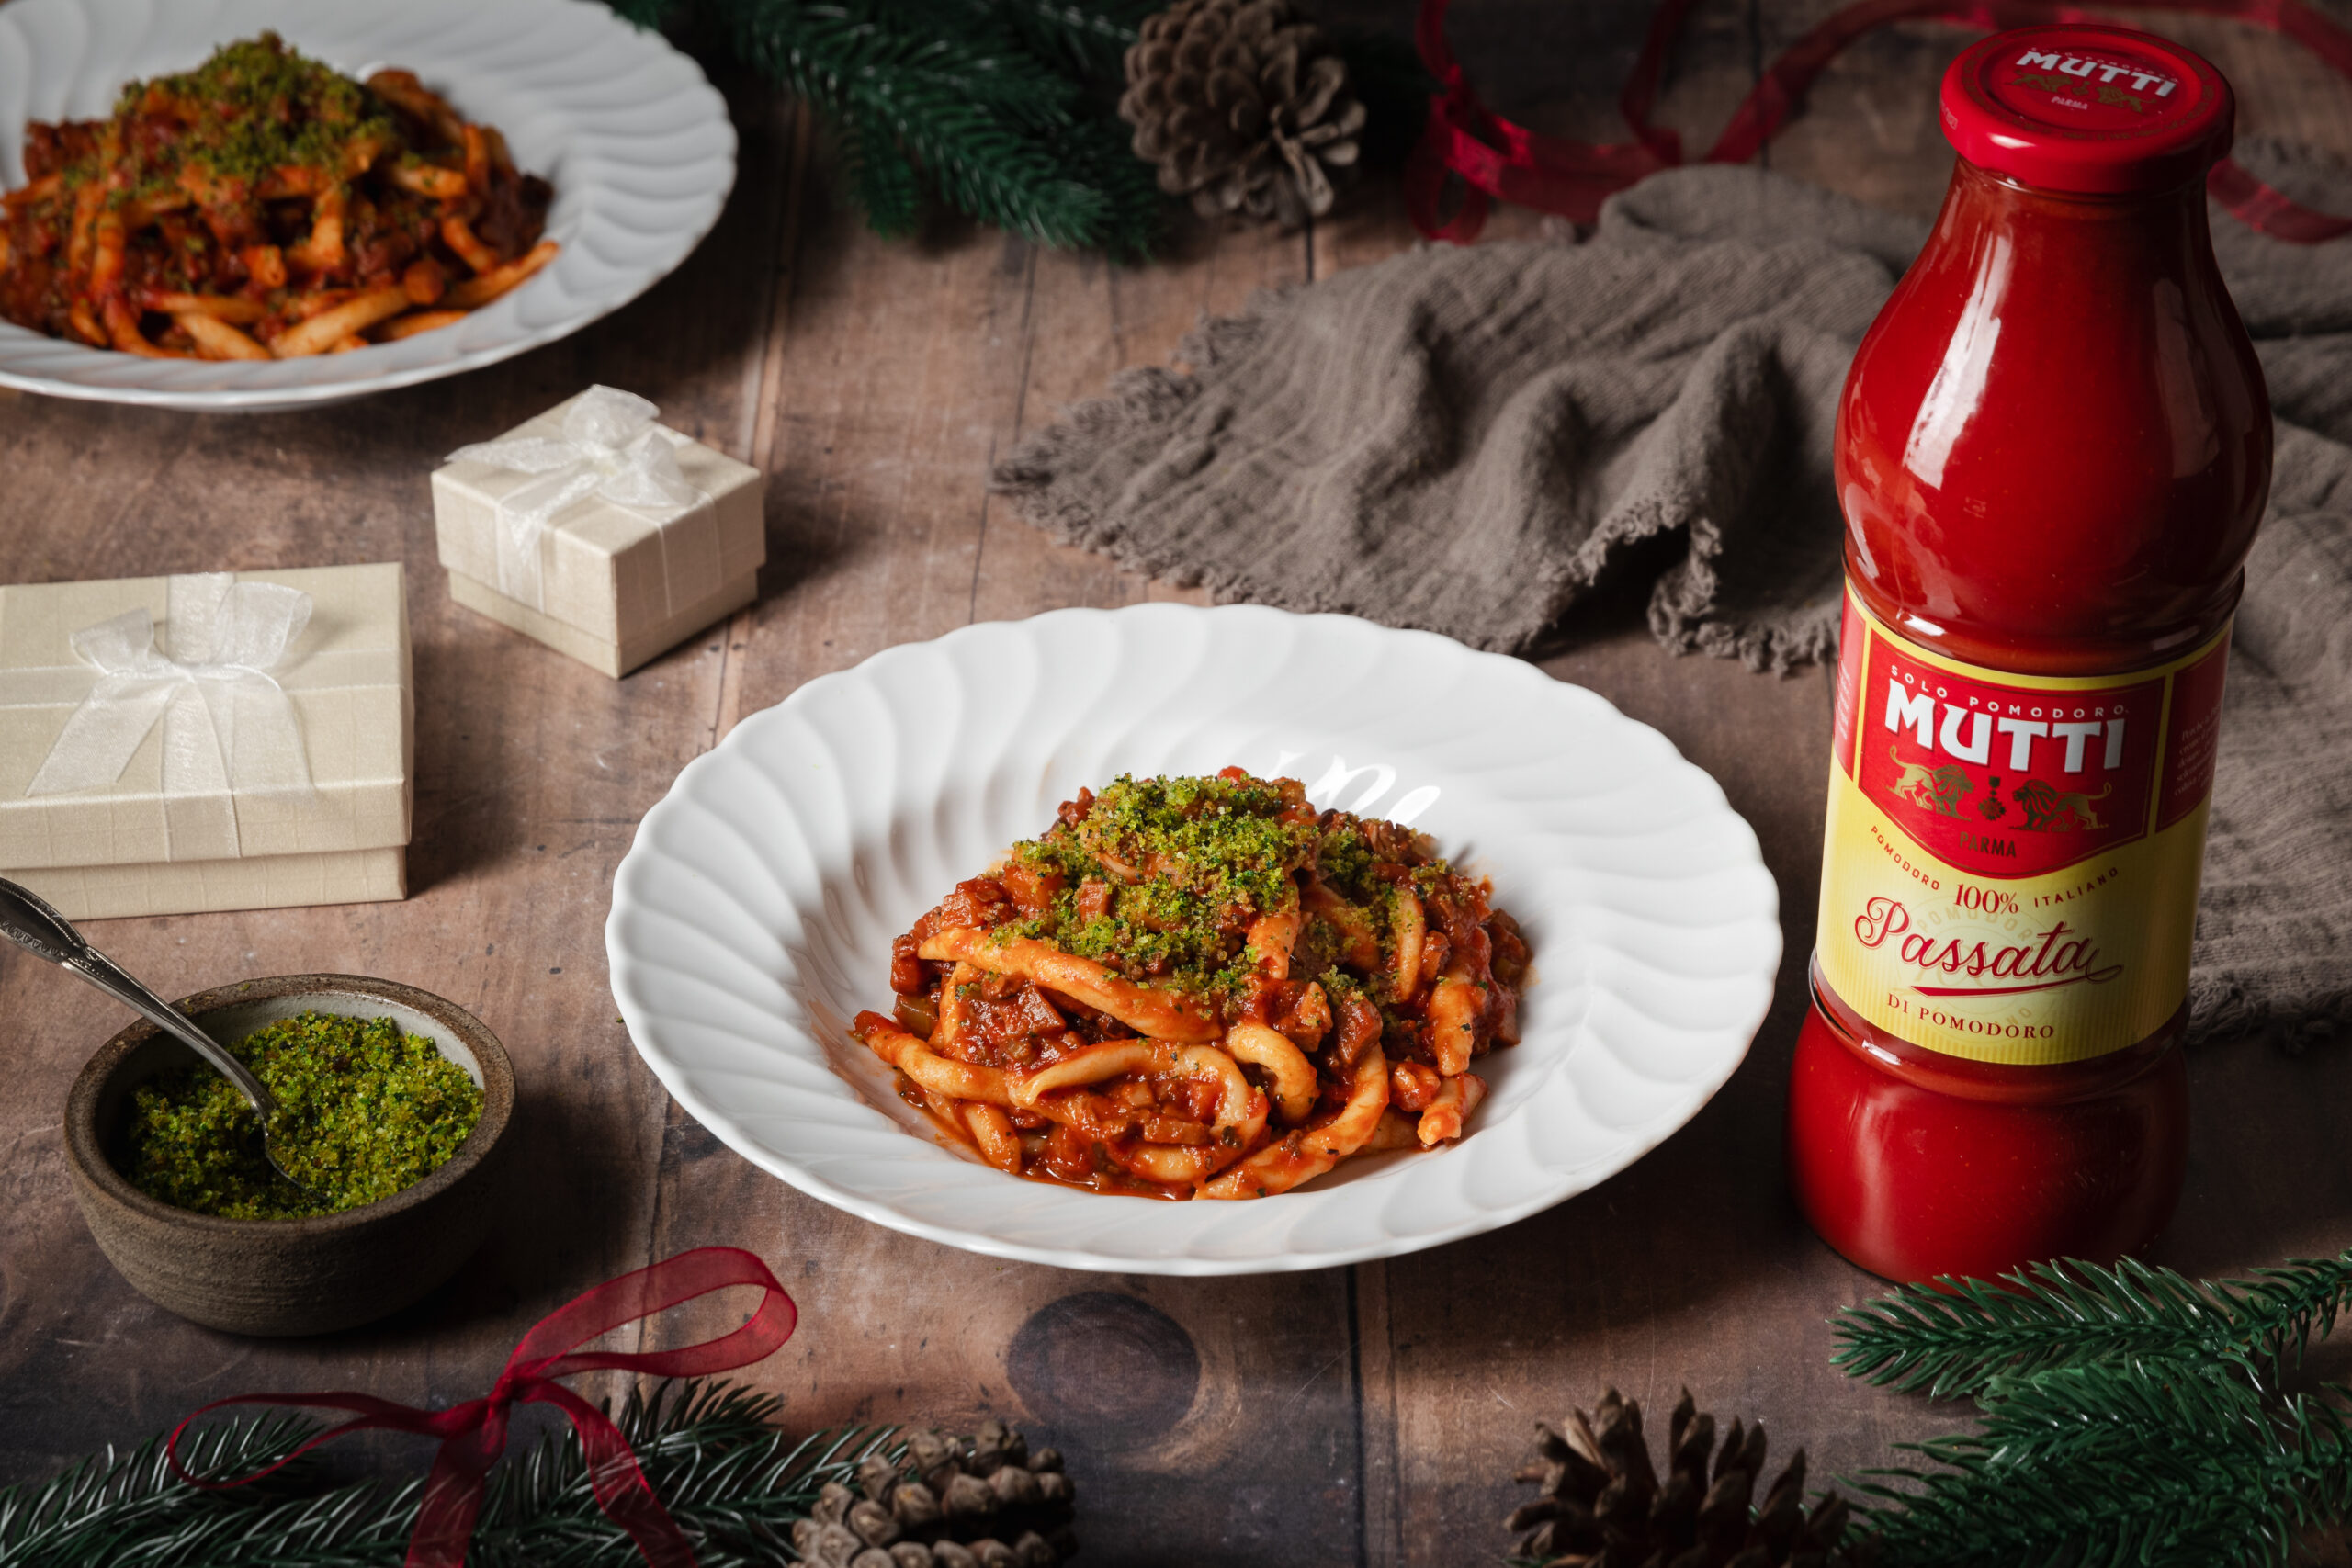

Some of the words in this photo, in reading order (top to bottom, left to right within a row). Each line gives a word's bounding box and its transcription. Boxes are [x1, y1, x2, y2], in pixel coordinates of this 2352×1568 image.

[2016, 51, 2177, 97] MUTTI
[2051, 96, 2088, 110] PARMA
[1891, 664, 1948, 698] SOLO
[1969, 696, 2124, 719] POMODORO
[1884, 677, 2125, 773] MUTTI
[1871, 826, 1940, 891] POMODORO
[1953, 883, 2019, 915] 100%
[2033, 867, 2119, 908] ITALIANO
[1959, 831, 2017, 859] PARMA
[1854, 896, 2124, 998] Passata
[1887, 992, 1909, 1014] DI
[1918, 1006, 2055, 1040] POMODORO
